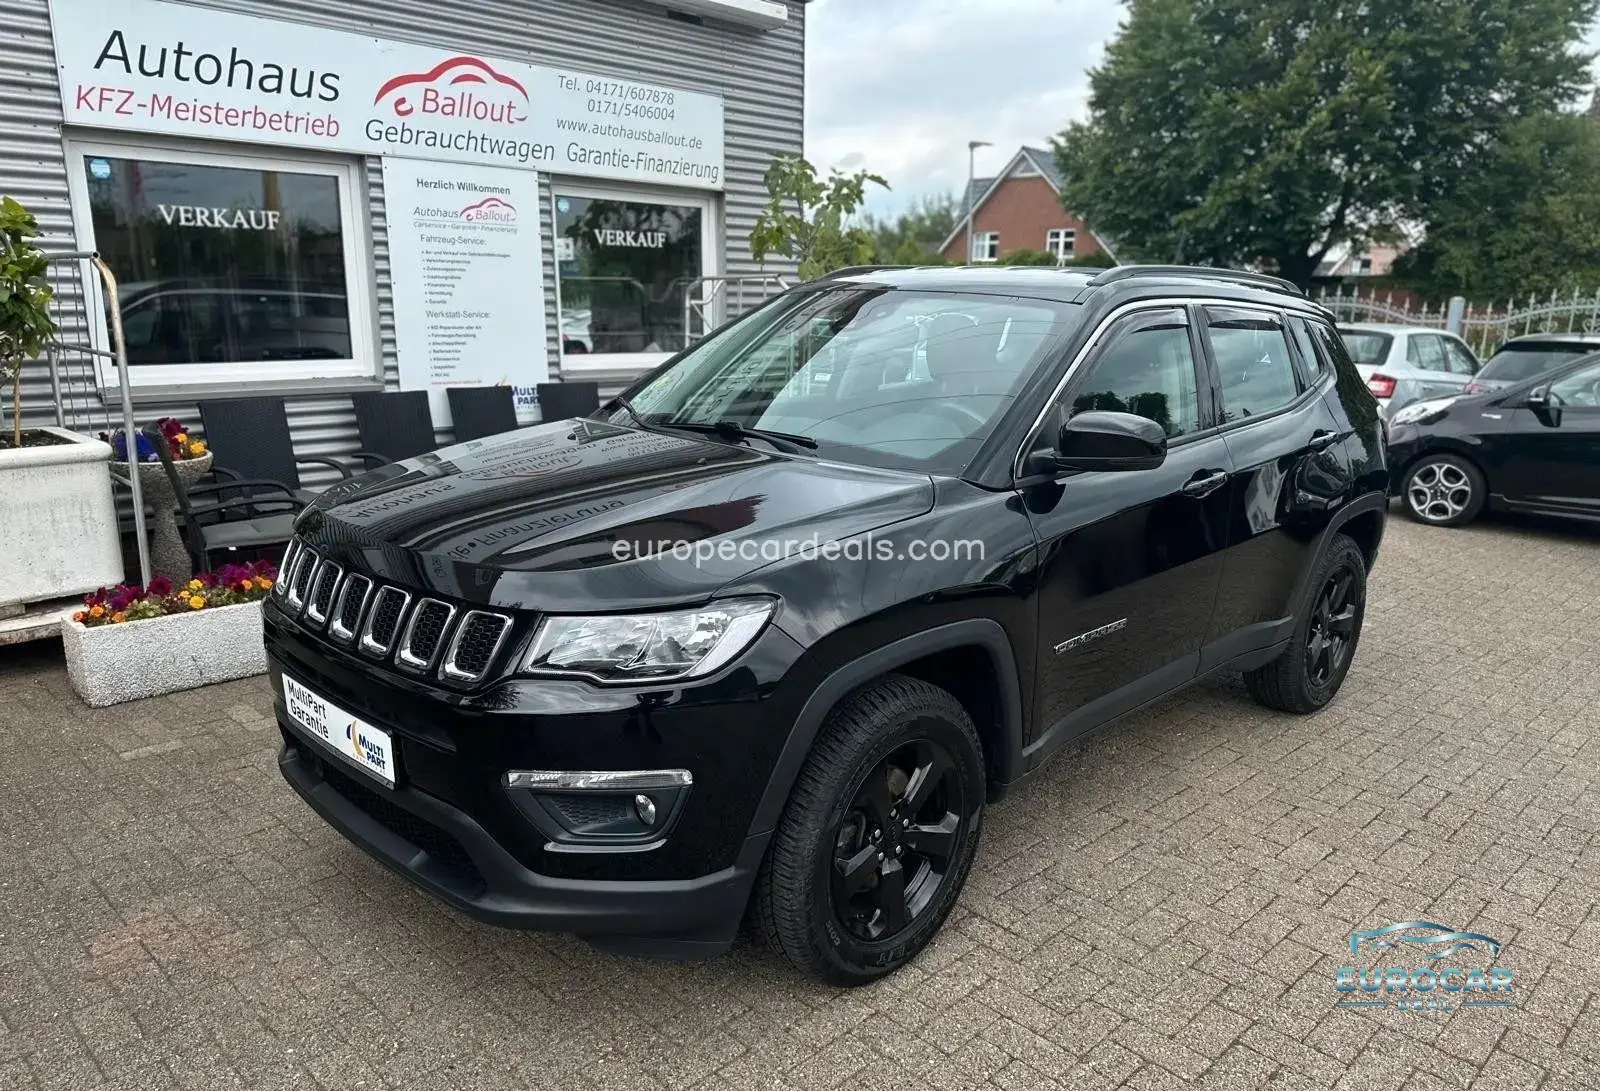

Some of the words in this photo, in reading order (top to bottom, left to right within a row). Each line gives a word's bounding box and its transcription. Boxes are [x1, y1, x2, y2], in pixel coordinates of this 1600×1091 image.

[93, 29, 340, 101] Autohaus
[558, 75, 581, 92] Tel.
[586, 79, 674, 105] 04171/607878
[75, 85, 340, 137] KFZ-Meisterbetrieb
[421, 88, 517, 124] Ballout
[587, 99, 676, 121] 0171/5406004
[365, 119, 555, 163] Gebrauchtwagen
[556, 118, 703, 150] www.autohausballout.de
[566, 142, 719, 184] Garantie-Finanzierung
[416, 178, 454, 190] Herzlich
[456, 182, 511, 195] Willkommen
[156, 203, 280, 230] VERKAUF
[413, 206, 459, 218] Autohaus
[475, 209, 510, 222] Ballout
[594, 229, 667, 248] VERKAUF
[511, 386, 538, 397] MULT
[517, 396, 539, 405] PAR
[287, 679, 327, 720] MultiPart
[290, 698, 329, 739] Garantie
[358, 732, 384, 759] MULTI
[366, 751, 386, 770] PART
